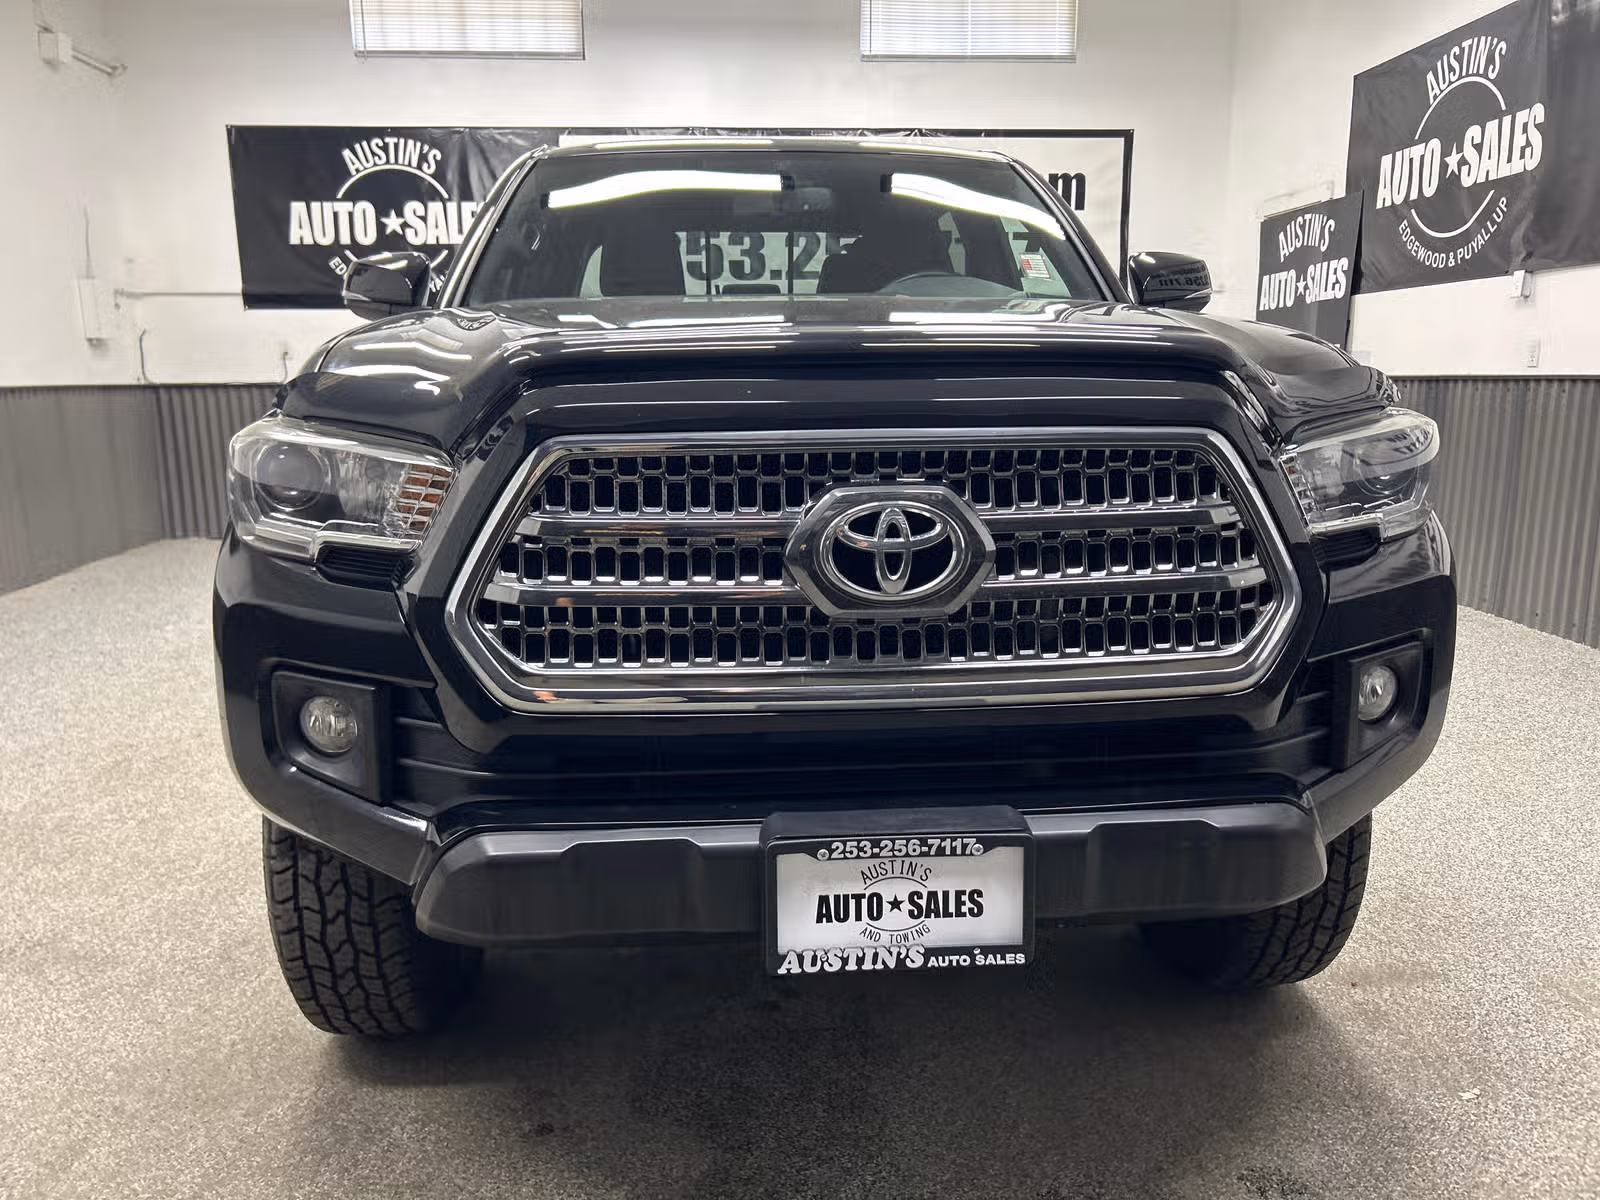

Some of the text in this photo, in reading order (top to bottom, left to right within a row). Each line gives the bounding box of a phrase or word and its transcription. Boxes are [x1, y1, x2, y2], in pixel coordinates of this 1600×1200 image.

[1425, 35, 1507, 105] AUSTIN'S
[341, 136, 442, 176] AUSTIN'S
[1376, 102, 1545, 210] AUTO SALES
[289, 201, 486, 246] AUTO SALE
[1278, 213, 1336, 263] AUSTIN'S
[1398, 219, 1446, 269] EDGEWOOD
[1448, 251, 1456, 267] &
[1259, 257, 1349, 311] AUTO SALES
[831, 838, 977, 860] 253-256-7117
[860, 859, 932, 885] AUSTIN'S
[815, 888, 984, 924] AUTO SALES
[859, 923, 931, 945] AND TOWING
[777, 944, 1026, 975] AUSTIN'S AUTO SALES
